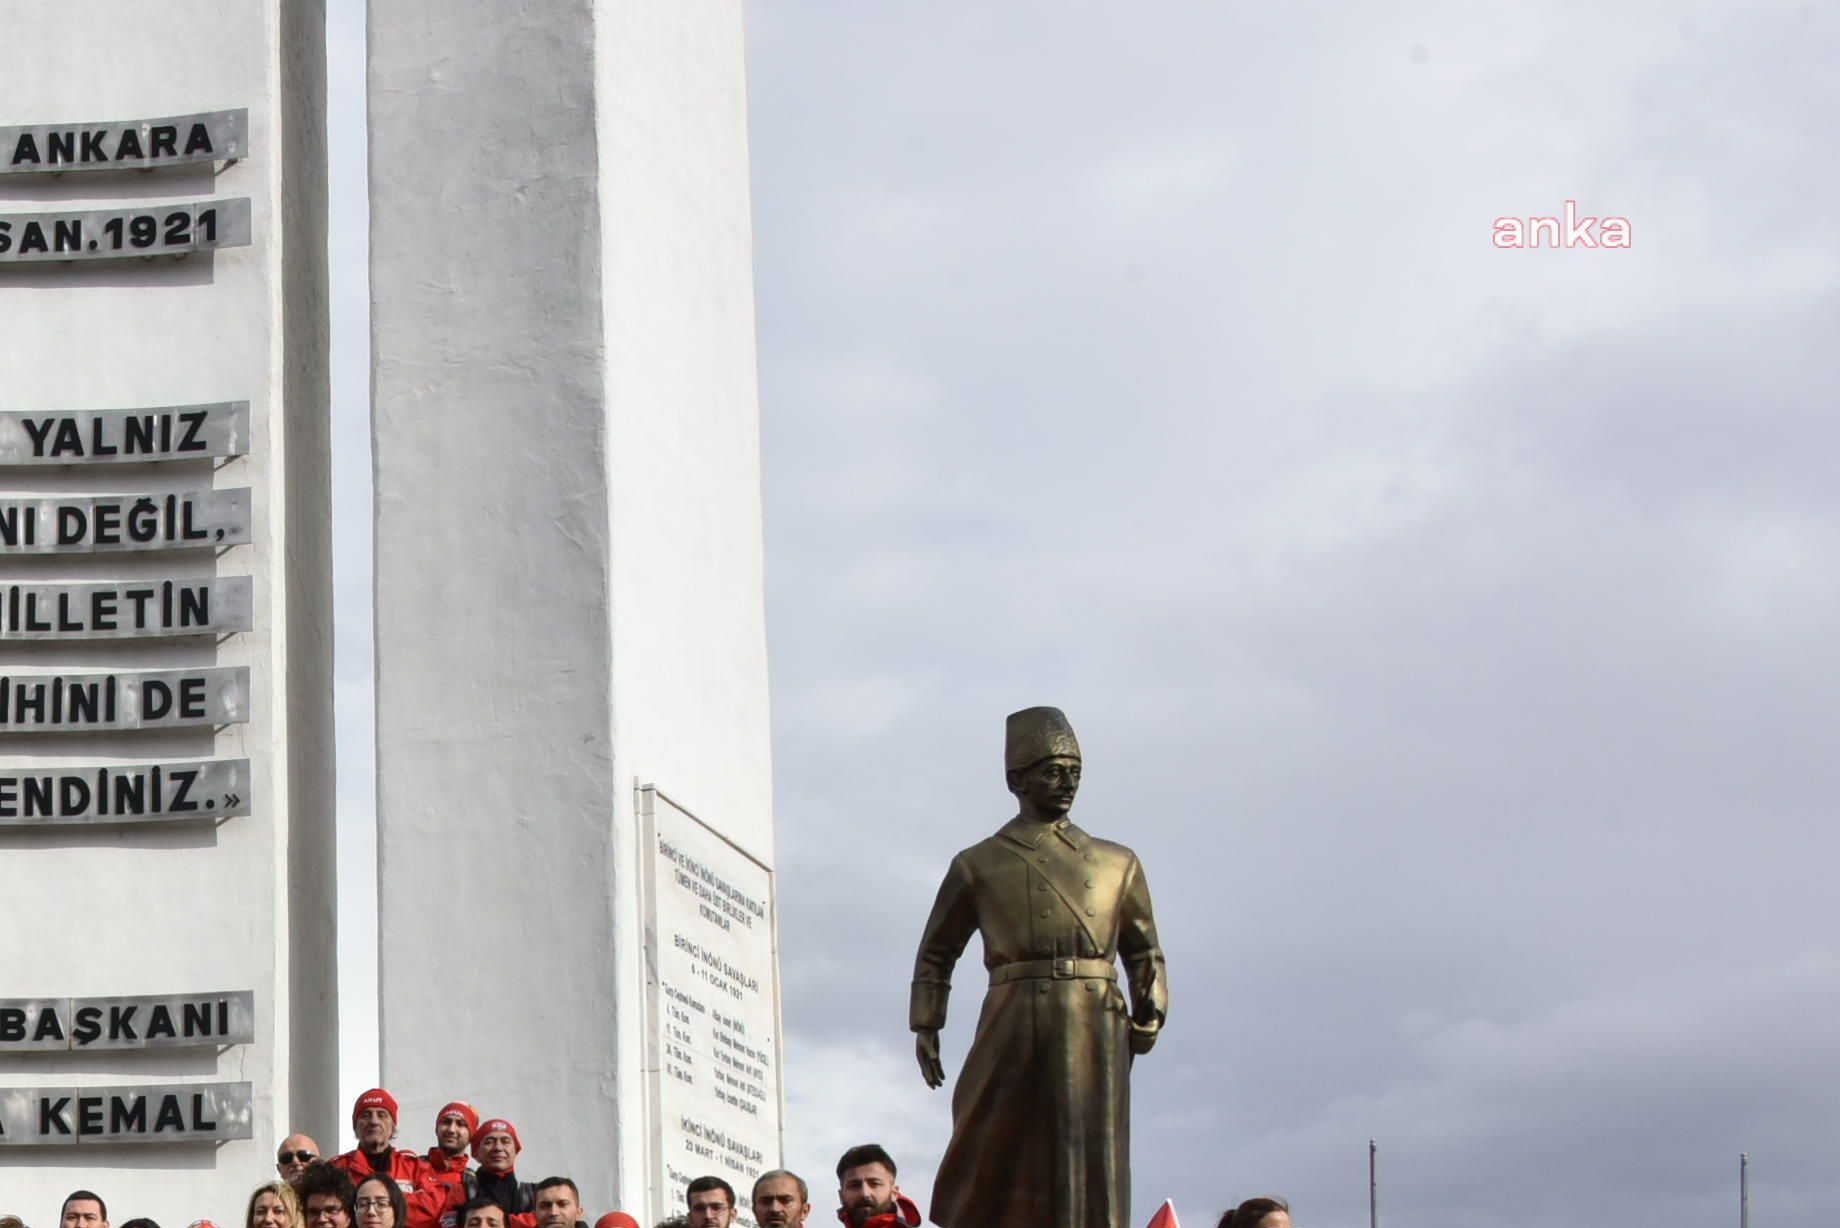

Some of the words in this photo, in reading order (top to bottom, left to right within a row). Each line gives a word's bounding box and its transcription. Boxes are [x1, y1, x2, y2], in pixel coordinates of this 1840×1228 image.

[11, 121, 215, 165] ANKARA
[21, 411, 207, 457] YALNIZ
[57, 493, 227, 546] DEĞİL,
[141, 677, 207, 721] DE
[674, 933, 700, 962] BİRİNCİ
[701, 947, 722, 973] İNÖNÜ
[724, 963, 759, 993] SAVAŞLARI
[709, 974, 728, 992] OCAK
[39, 1092, 217, 1136] KEMAL
[681, 1114, 702, 1139] İKİNCİ
[703, 1124, 725, 1148] İNÖNÜ
[727, 1138, 763, 1165] SAVAŞLARI
[695, 1143, 713, 1161] MART
